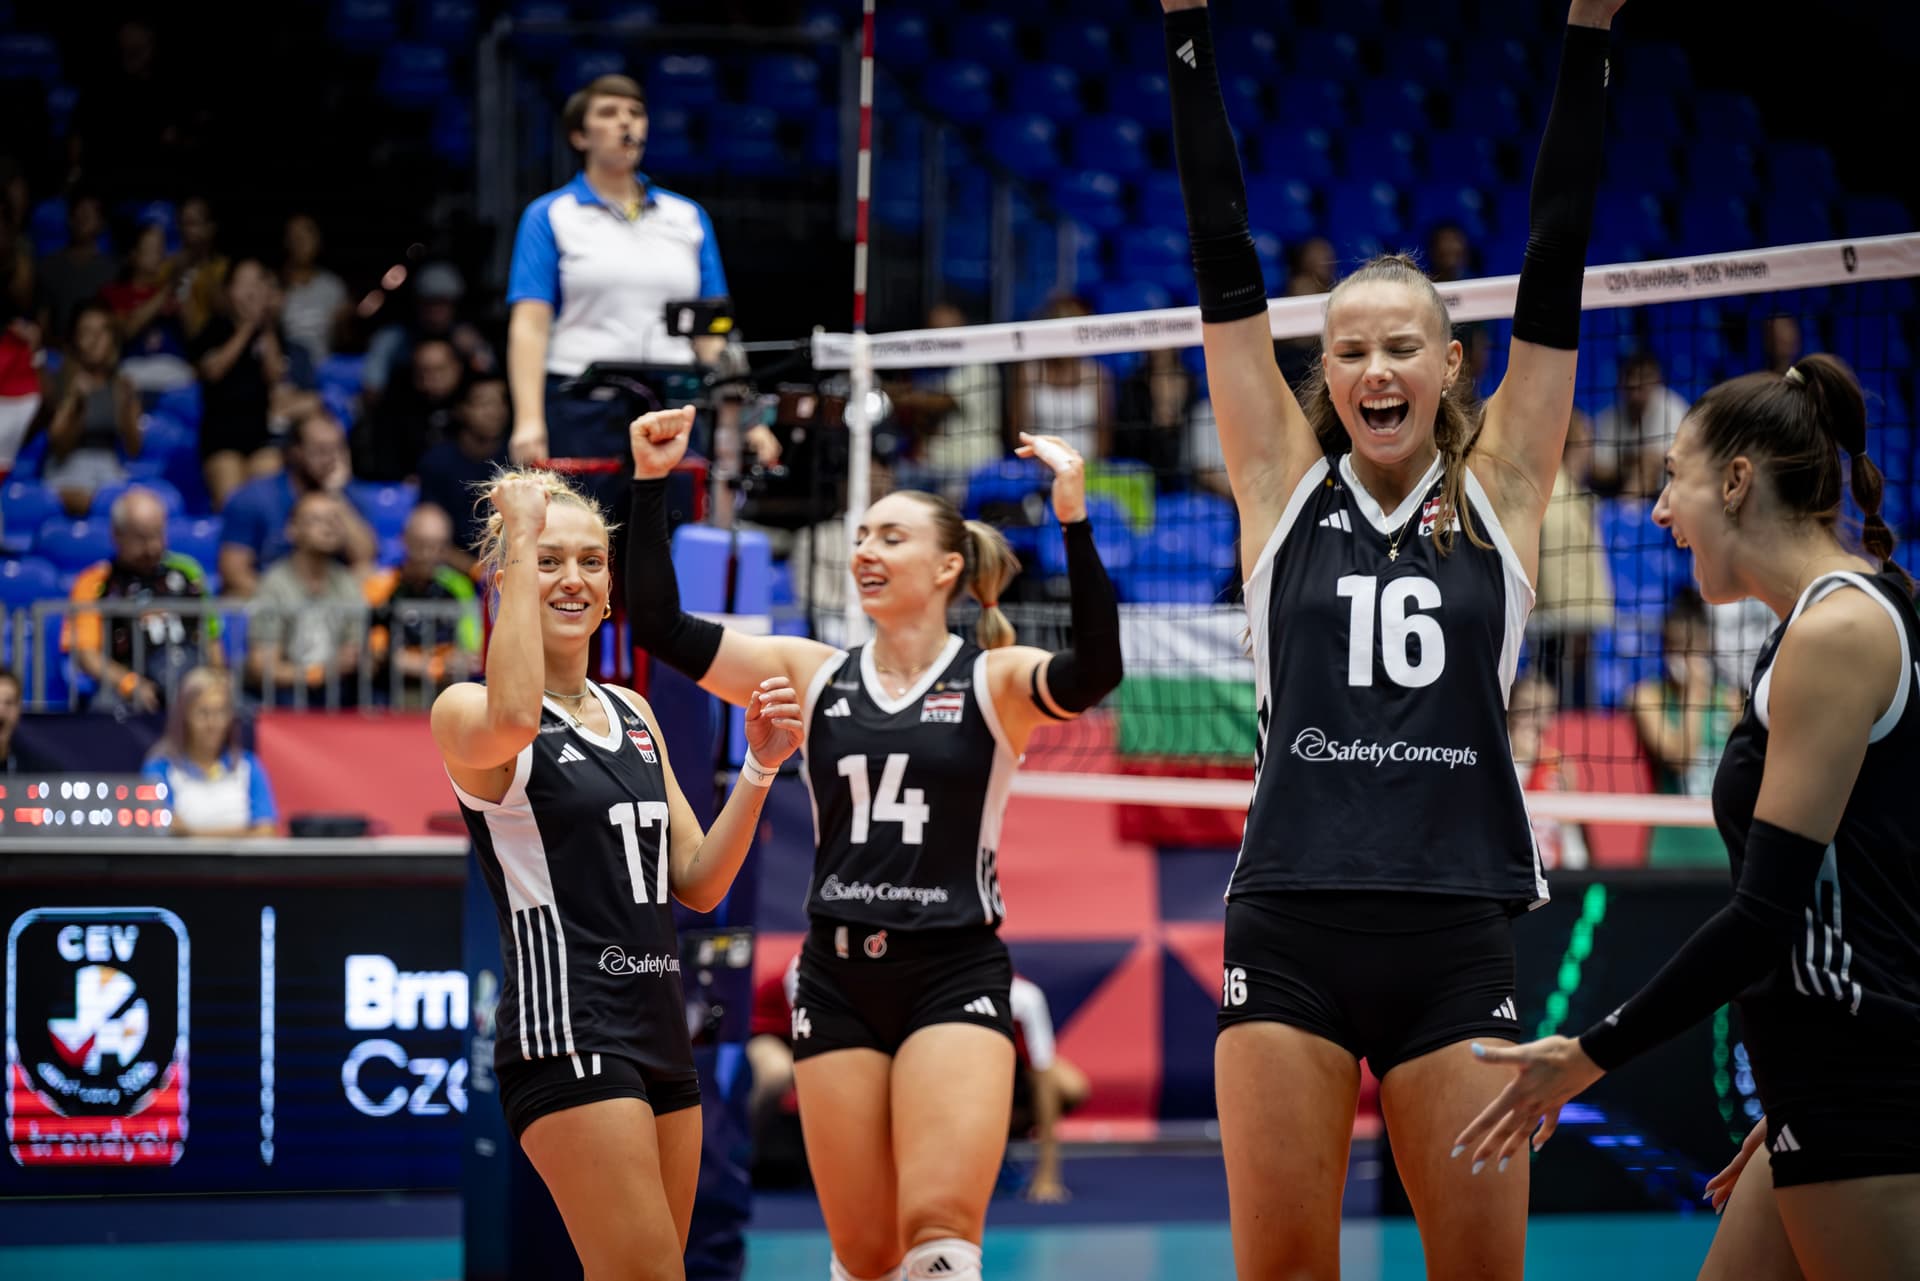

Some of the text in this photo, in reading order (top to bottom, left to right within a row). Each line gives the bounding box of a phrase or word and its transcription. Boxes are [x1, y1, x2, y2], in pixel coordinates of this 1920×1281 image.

[1336, 574, 1446, 688] 16
[1327, 739, 1477, 769] SafetyConcepts
[837, 753, 930, 845] 14
[608, 801, 669, 904] 17
[836, 881, 949, 906] SafetyConcepts
[57, 925, 140, 962] CEV
[1224, 967, 1248, 1008] 16
